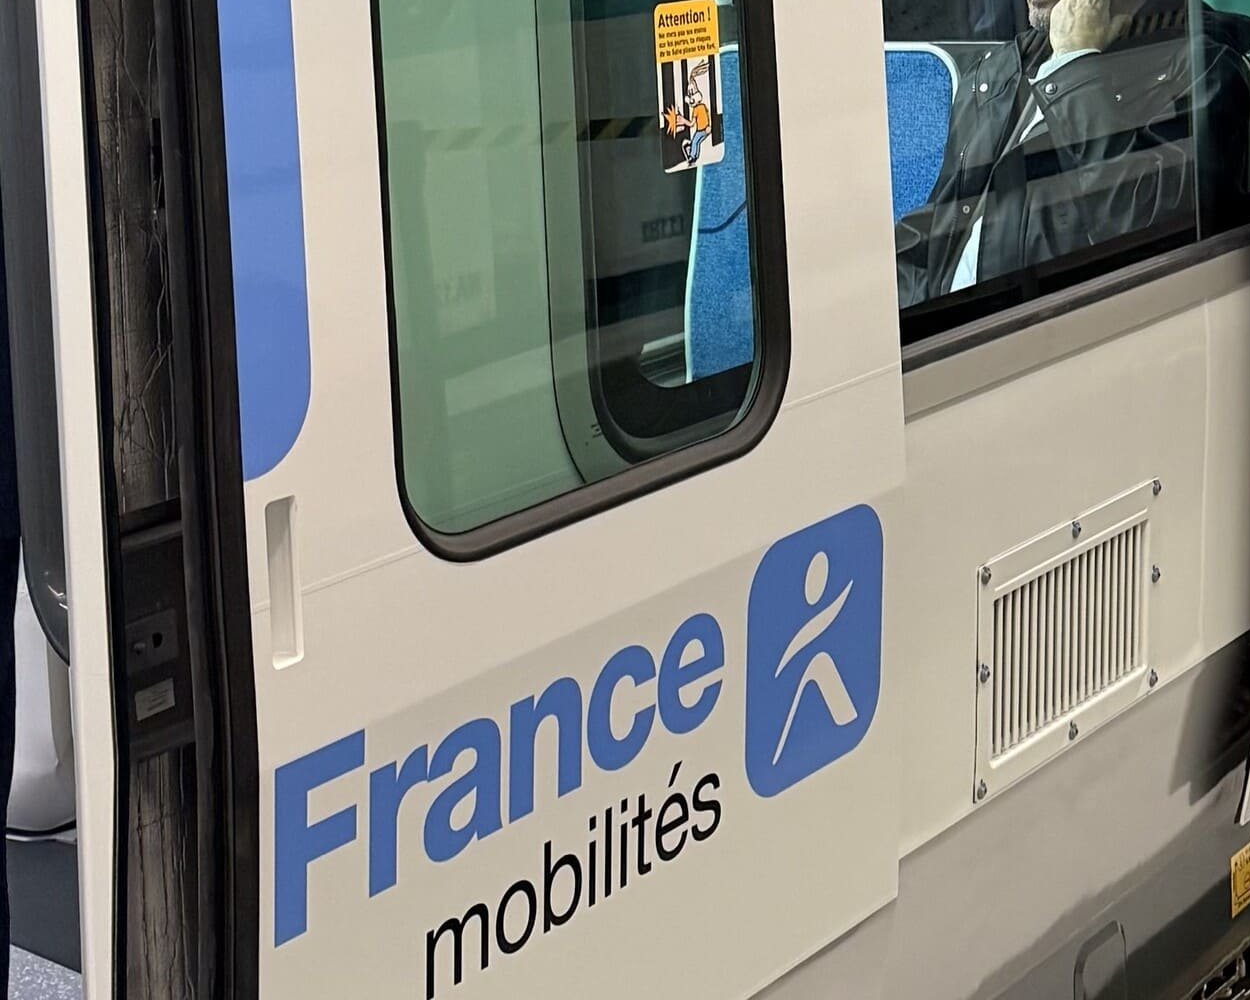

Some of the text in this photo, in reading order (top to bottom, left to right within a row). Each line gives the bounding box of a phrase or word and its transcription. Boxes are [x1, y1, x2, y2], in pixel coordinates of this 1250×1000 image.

[658, 8, 705, 28] Attention
[274, 613, 724, 949] France
[426, 761, 721, 1000] mobilités
